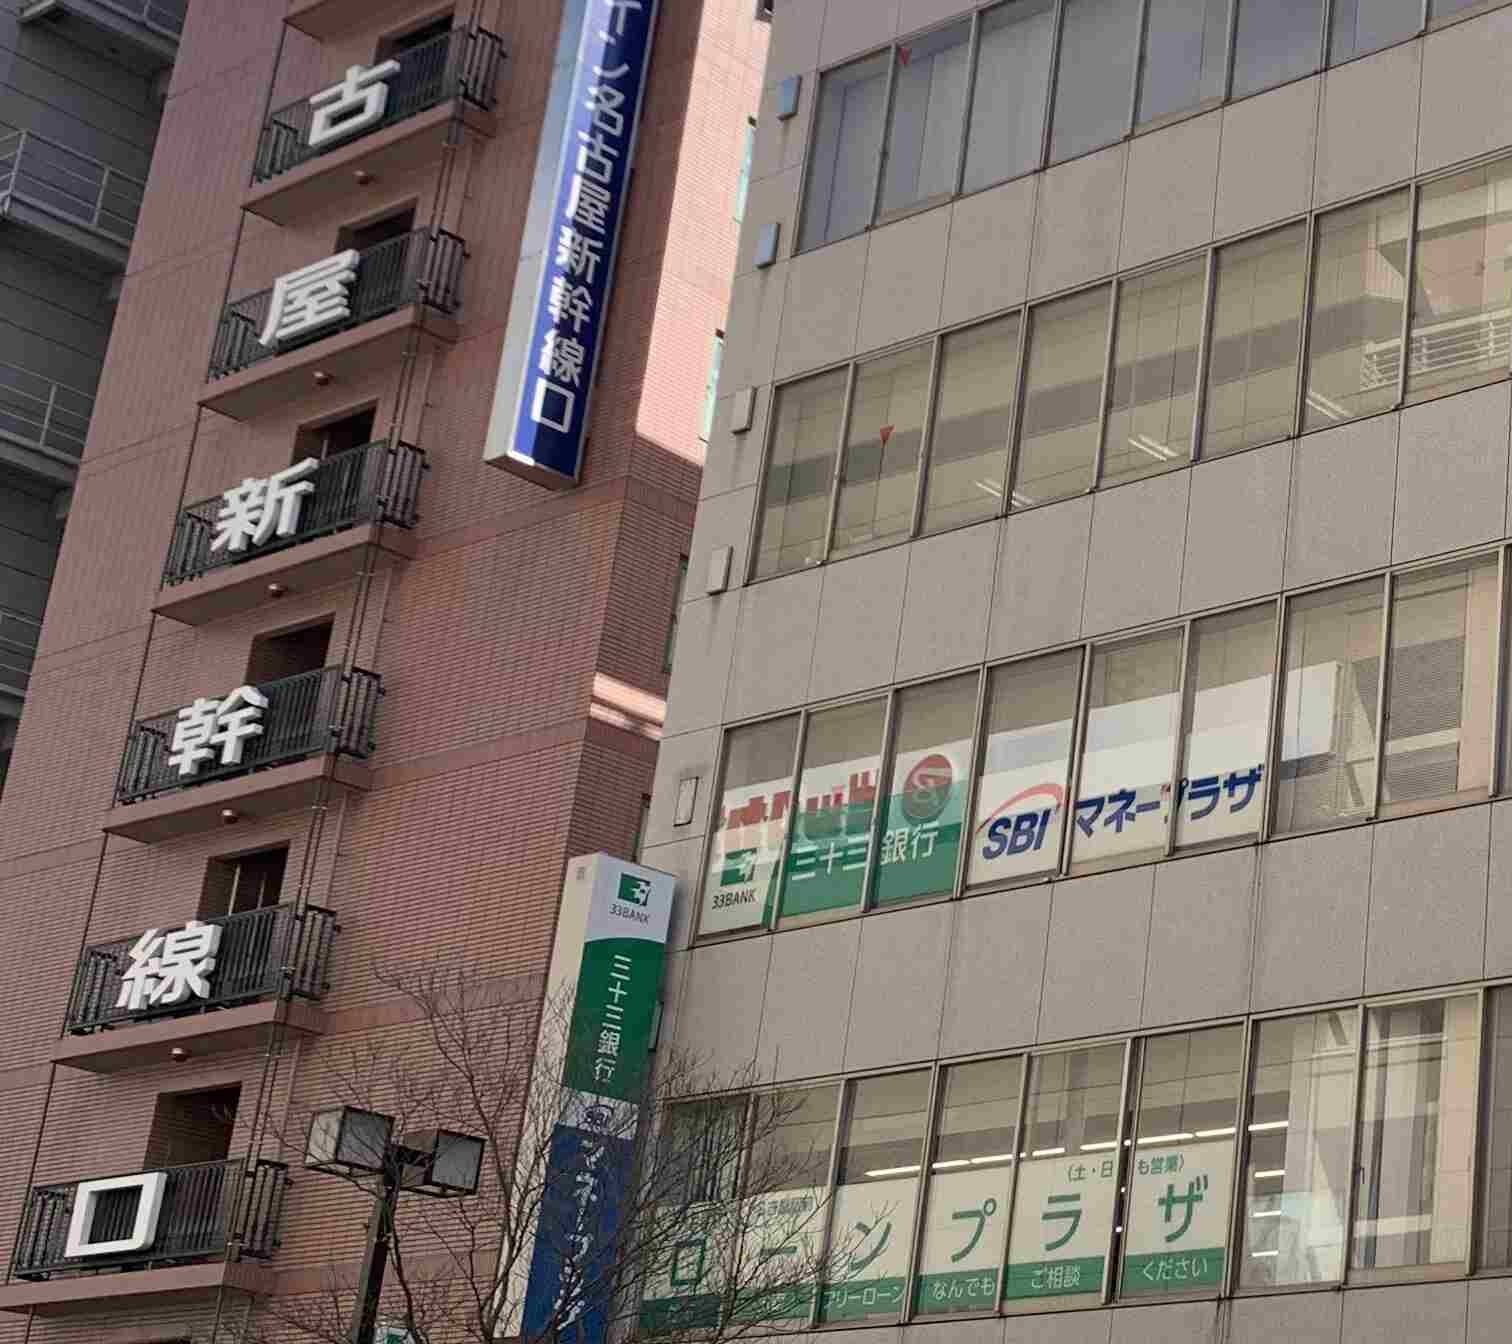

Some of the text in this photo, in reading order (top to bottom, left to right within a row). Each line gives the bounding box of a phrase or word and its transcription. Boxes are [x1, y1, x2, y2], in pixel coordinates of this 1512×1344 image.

[791, 821, 940, 881] 三十三銀行
[982, 808, 1053, 860] SBI
[609, 903, 651, 925] 33BANK
[711, 888, 757, 910] 33BANK
[593, 954, 633, 1084] 三十三銀行
[932, 1276, 996, 1300] なんでも
[1031, 1264, 1081, 1289] ご相談
[1142, 1255, 1208, 1281] ください
